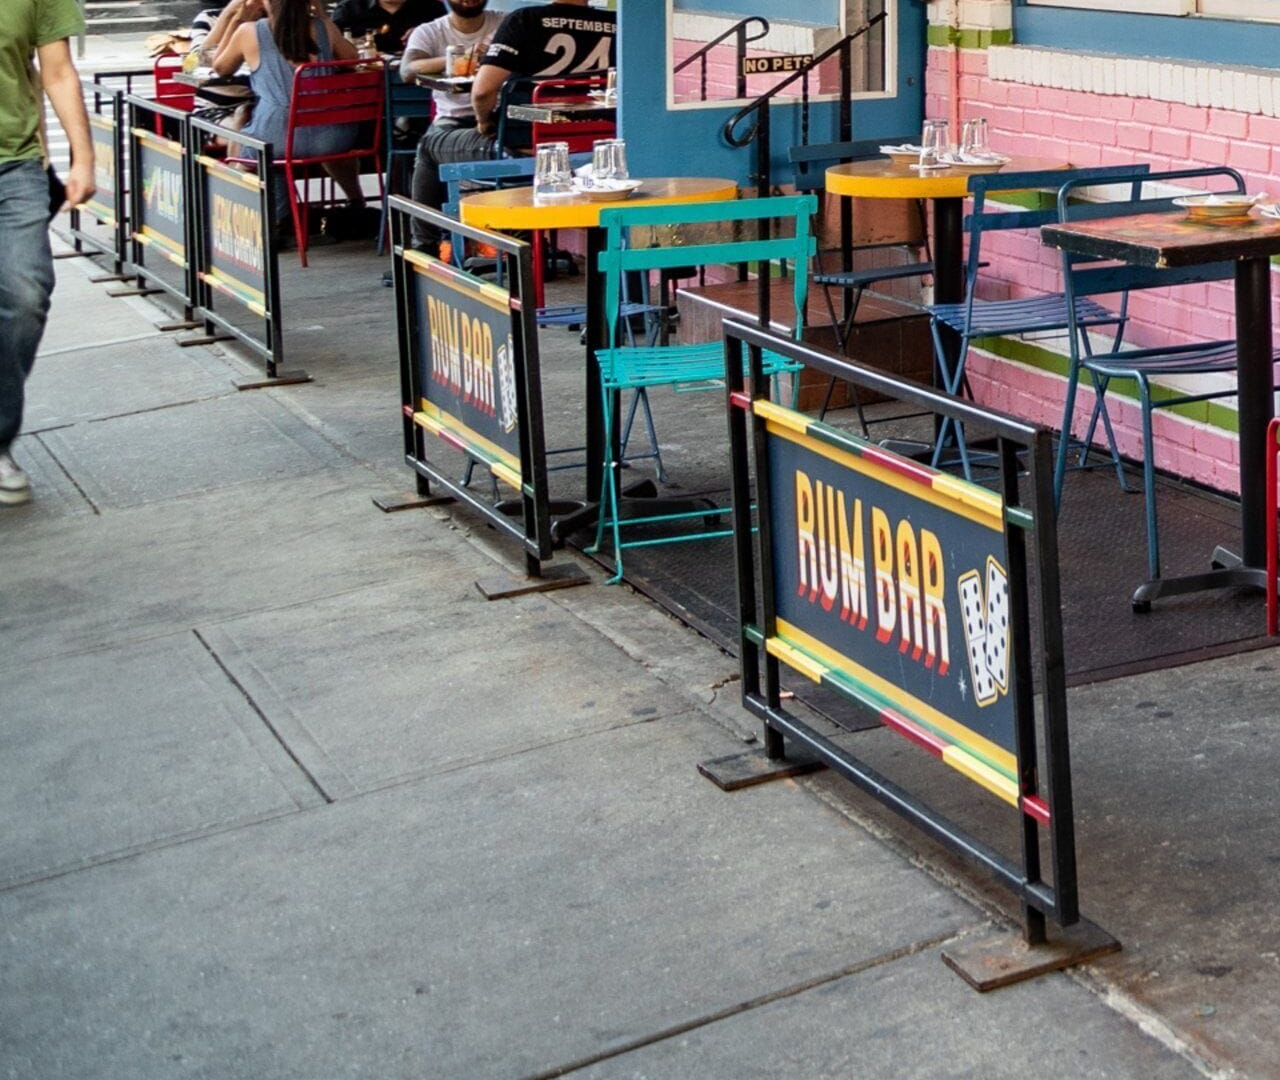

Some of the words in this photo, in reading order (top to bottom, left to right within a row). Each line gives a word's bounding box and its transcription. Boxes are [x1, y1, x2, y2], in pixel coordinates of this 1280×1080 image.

[533, 32, 612, 77] 24
[745, 58, 769, 74] NO
[772, 55, 813, 72] PETS
[427, 294, 462, 395] RUM
[460, 311, 496, 418] BAR
[795, 469, 870, 632] RUM
[870, 506, 950, 677] BAR
